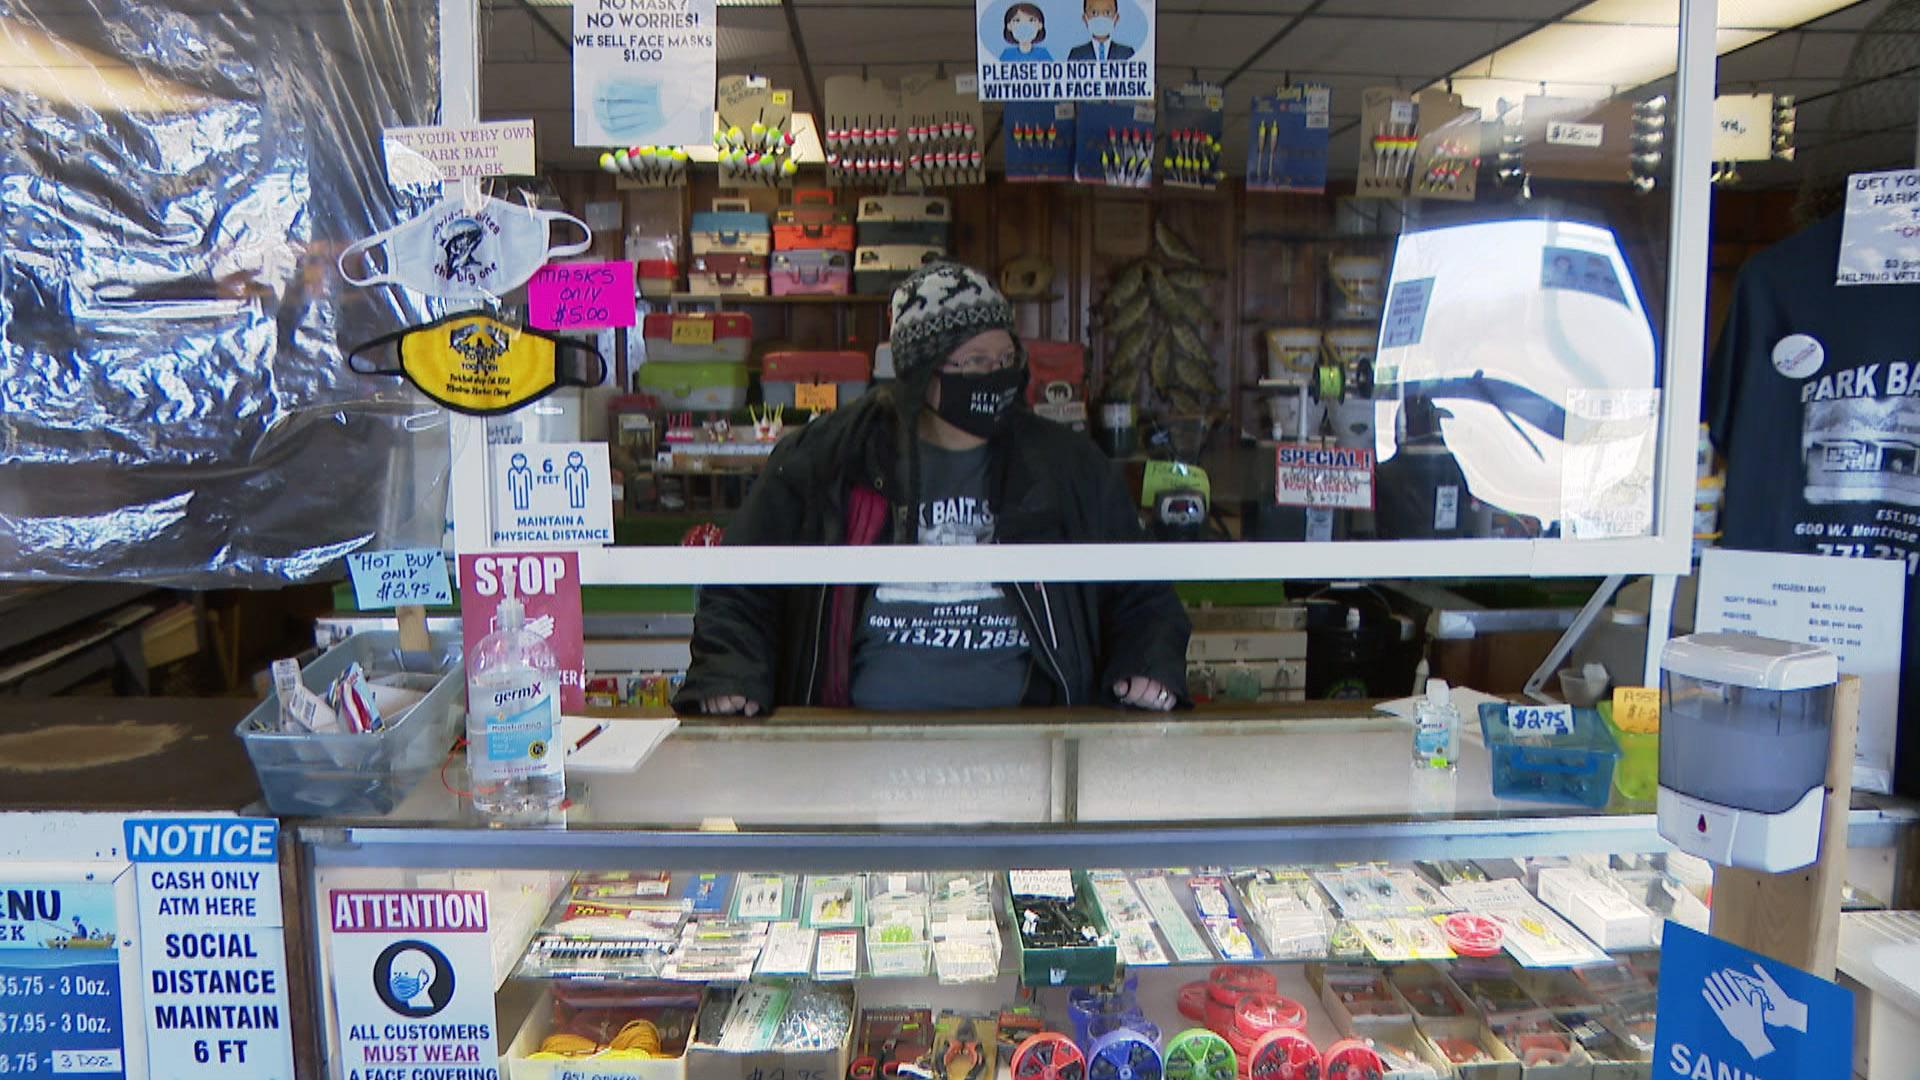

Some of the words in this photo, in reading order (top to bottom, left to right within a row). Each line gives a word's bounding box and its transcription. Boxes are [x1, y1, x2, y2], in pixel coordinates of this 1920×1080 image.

[600, 0, 625, 10] NO
[587, 13, 614, 28] NO
[619, 13, 699, 28] WORRIES!
[575, 35, 593, 48] WE
[597, 35, 626, 48] SELL
[630, 35, 664, 48] FACE
[668, 34, 713, 48] MASKS
[624, 49, 662, 63] $1.00
[982, 63, 1038, 81] PLEASE
[1042, 63, 1063, 80] DO
[1067, 62, 1096, 79] NOT
[1100, 62, 1147, 79] ENTER
[984, 83, 1051, 98] WITHOUT
[1053, 83, 1063, 98] A
[1067, 82, 1101, 97] FACE
[1105, 81, 1151, 97] MASK.
[418, 132, 456, 145] YOUR
[460, 129, 500, 142] VERY
[503, 127, 534, 140] OWN
[465, 146, 499, 158] BAIT
[461, 163, 504, 176] MASK
[1856, 177, 1889, 190] GET
[1874, 191, 1919, 205] PARK
[479, 262, 498, 279] one
[550, 302, 609, 327] $5.00
[1801, 363, 1881, 403] PARK
[543, 458, 553, 474] 6
[537, 475, 559, 485] FEET
[933, 496, 976, 525] BAIT
[517, 516, 573, 527] MAINTAIN
[577, 515, 585, 525] A
[494, 531, 549, 541] PHYSICAL
[552, 529, 609, 540] DISTANCE
[1795, 523, 1824, 535] 600
[1827, 524, 1847, 536] W.
[1851, 524, 1919, 542] Montrose
[474, 556, 566, 596] STOP
[376, 582, 431, 603] $2.95
[869, 615, 890, 627] 600
[911, 617, 969, 628] Montrose
[1512, 709, 1565, 730] $2.95
[132, 824, 275, 856] NOTICE
[152, 872, 205, 890] CASH
[211, 871, 260, 890] ONLY
[158, 898, 199, 916] ATM
[206, 898, 256, 917] HERE
[335, 893, 484, 928] ATTENTION
[165, 933, 258, 958] SOCIAL
[60, 976, 71, 996] 3
[76, 976, 110, 996] Doz.
[152, 970, 276, 994] DISTANCE
[61, 1013, 72, 1033] 3
[77, 1013, 111, 1033] Doz.
[155, 1005, 279, 1029] MAINTAIN
[349, 1024, 380, 1041] ALL
[384, 1024, 490, 1041] CUSTOMERS
[194, 1040, 209, 1063] 6
[218, 1040, 248, 1063] FT
[363, 1046, 418, 1062] MUST
[424, 1045, 480, 1062] WEAR
[60, 1054, 72, 1068] 3
[349, 1069, 360, 1080] A
[365, 1069, 406, 1080] FACE
[412, 1068, 497, 1080] COVERING
